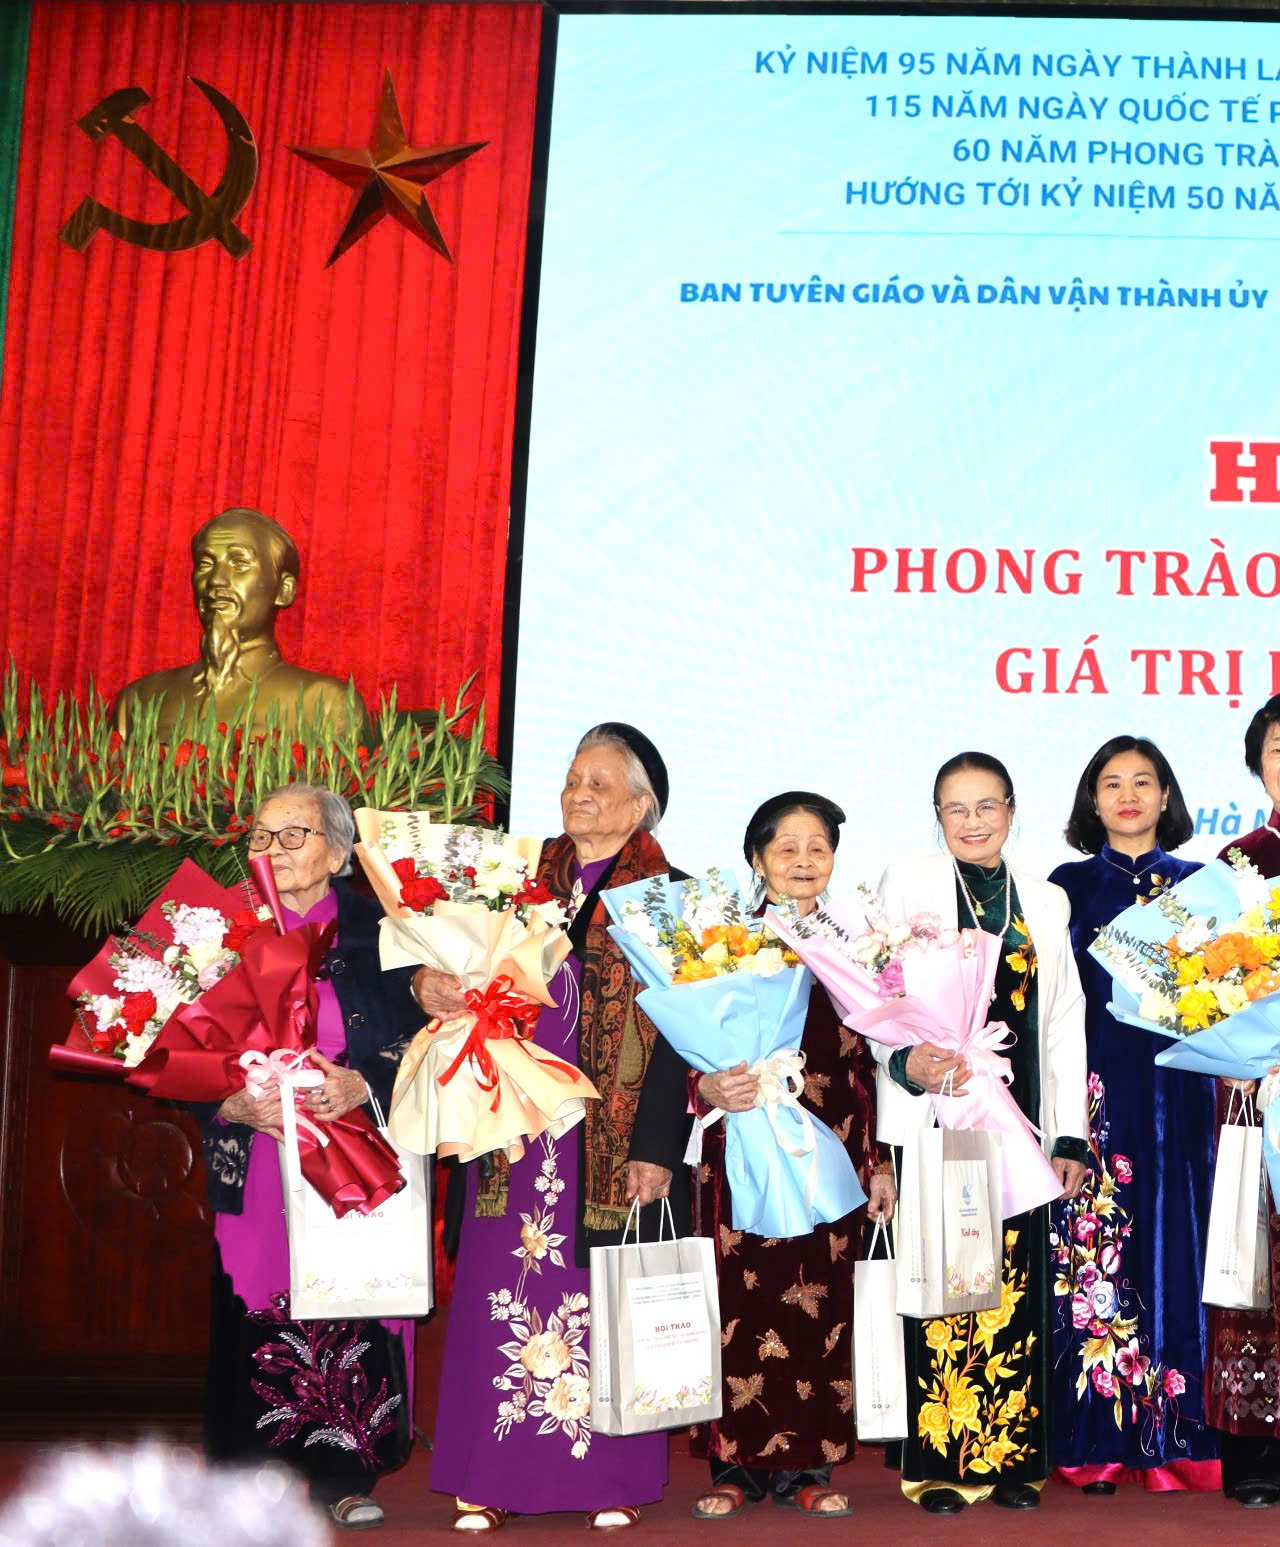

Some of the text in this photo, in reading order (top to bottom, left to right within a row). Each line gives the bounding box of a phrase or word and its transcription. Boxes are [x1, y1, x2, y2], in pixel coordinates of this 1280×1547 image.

[755, 43, 797, 75] KỶ
[806, 45, 888, 80] NIỆM
[898, 51, 936, 76] 95
[946, 46, 1022, 77] NĂM
[1032, 48, 1123, 78] NGÀY
[1130, 50, 1247, 81] THÀNH
[865, 94, 922, 118] 115
[932, 89, 1008, 119] NĂM
[1018, 90, 1109, 121] NGÀY
[1118, 91, 1210, 125] QUỐC
[1218, 93, 1262, 124] TẾ
[952, 138, 991, 163] 60
[1001, 133, 1077, 164] NĂM
[1087, 140, 1204, 167] PHONG
[845, 175, 965, 206] HƯỚNG
[975, 176, 1030, 207] TỚI
[1040, 175, 1083, 208] KỶ
[1093, 179, 1176, 215] NIỆM
[1187, 185, 1225, 211] 50
[680, 274, 1269, 313] BAN TUYÊN GIÁO VÀ DÂN VẬN THÀNH ỦY
[849, 546, 1084, 596] PHONG
[994, 633, 1110, 695] GIÁ
[1129, 648, 1244, 710] TRỊ
[1194, 801, 1242, 836] Hà
